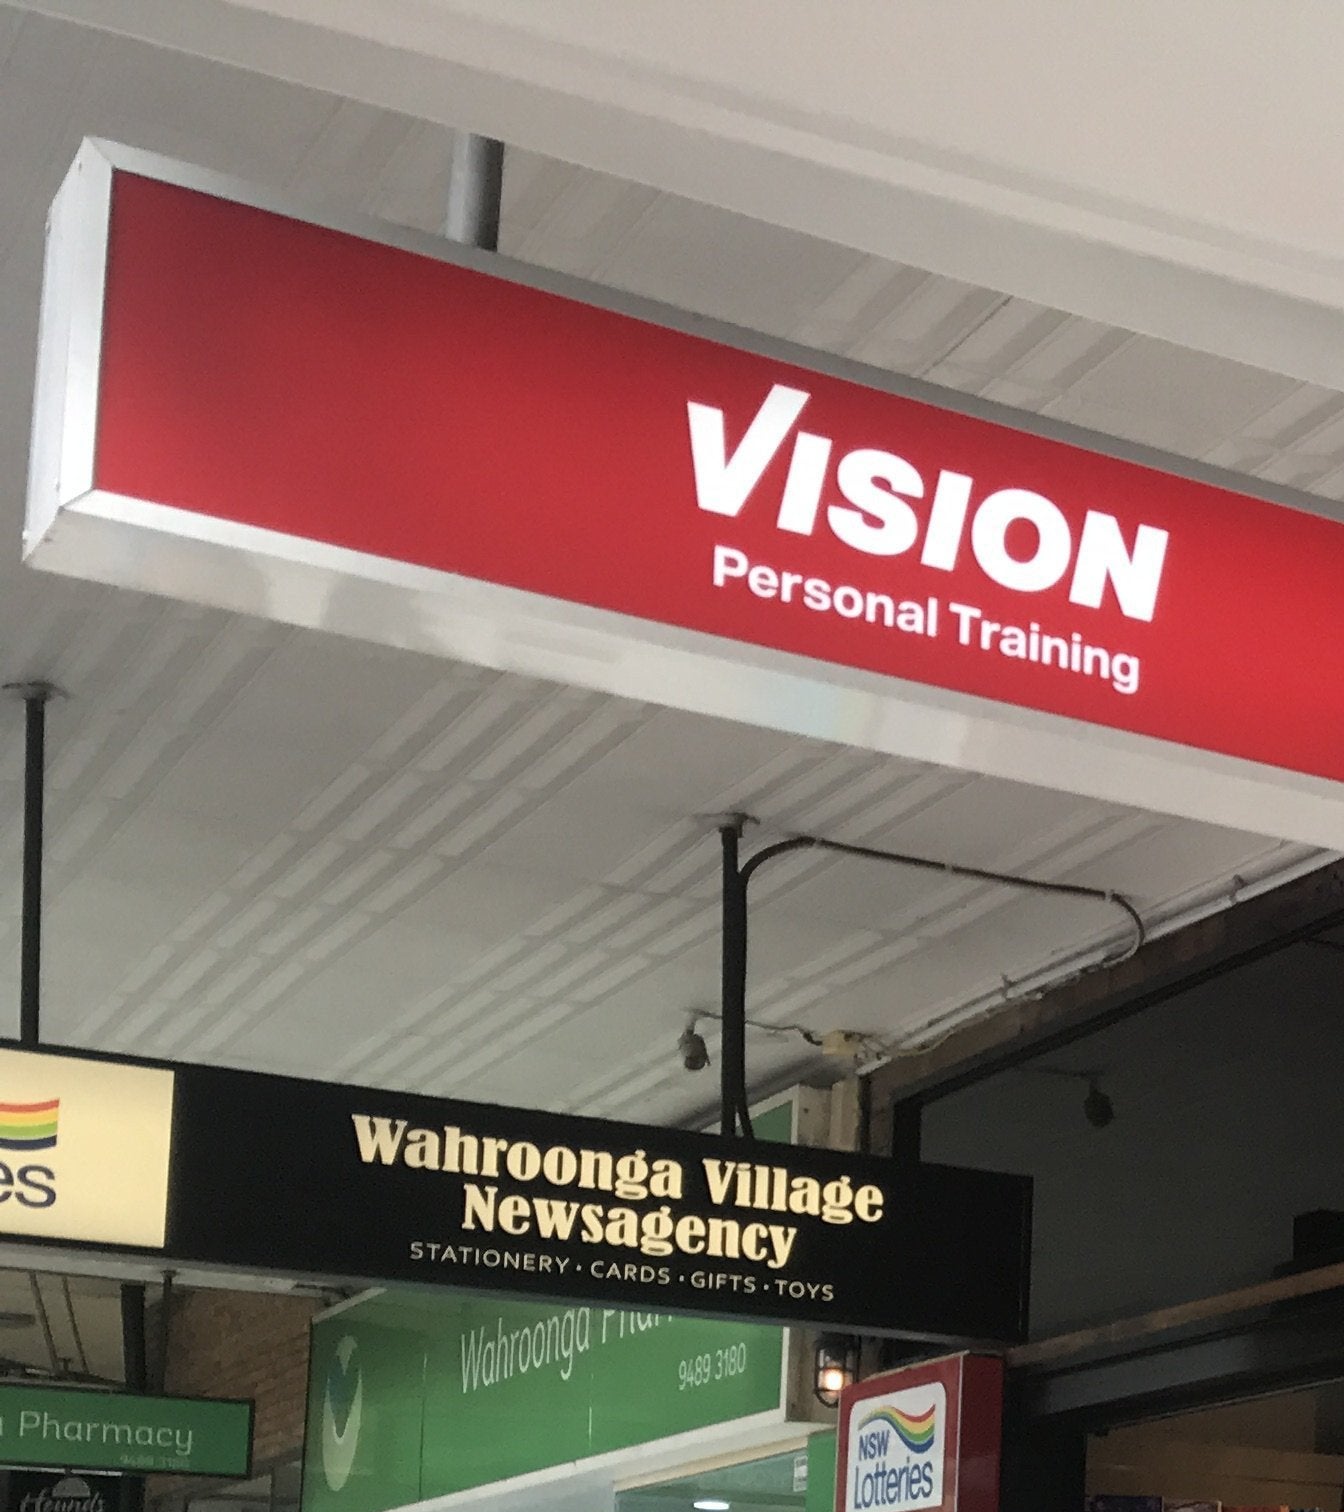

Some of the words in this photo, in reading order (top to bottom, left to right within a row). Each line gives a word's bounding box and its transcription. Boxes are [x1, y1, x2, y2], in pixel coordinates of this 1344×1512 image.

[686, 383, 1169, 622] VISION
[711, 544, 937, 638] Personal
[948, 601, 1140, 695] Training
[351, 1113, 683, 1200] Wahroonga
[701, 1157, 884, 1225] Village
[461, 1183, 798, 1269] Newsagency
[410, 1241, 571, 1275] STATIONERY
[590, 1260, 670, 1286] CARDS
[690, 1270, 756, 1293] GIFTS
[774, 1279, 835, 1301] TOYS
[461, 1307, 590, 1394] Wahroonga
[678, 1353, 711, 1391] 9489
[715, 1342, 747, 1380] 3180
[19, 1411, 193, 1456] Pharmacy
[858, 1429, 890, 1461] NSW
[853, 1456, 934, 1509] Lotteries
